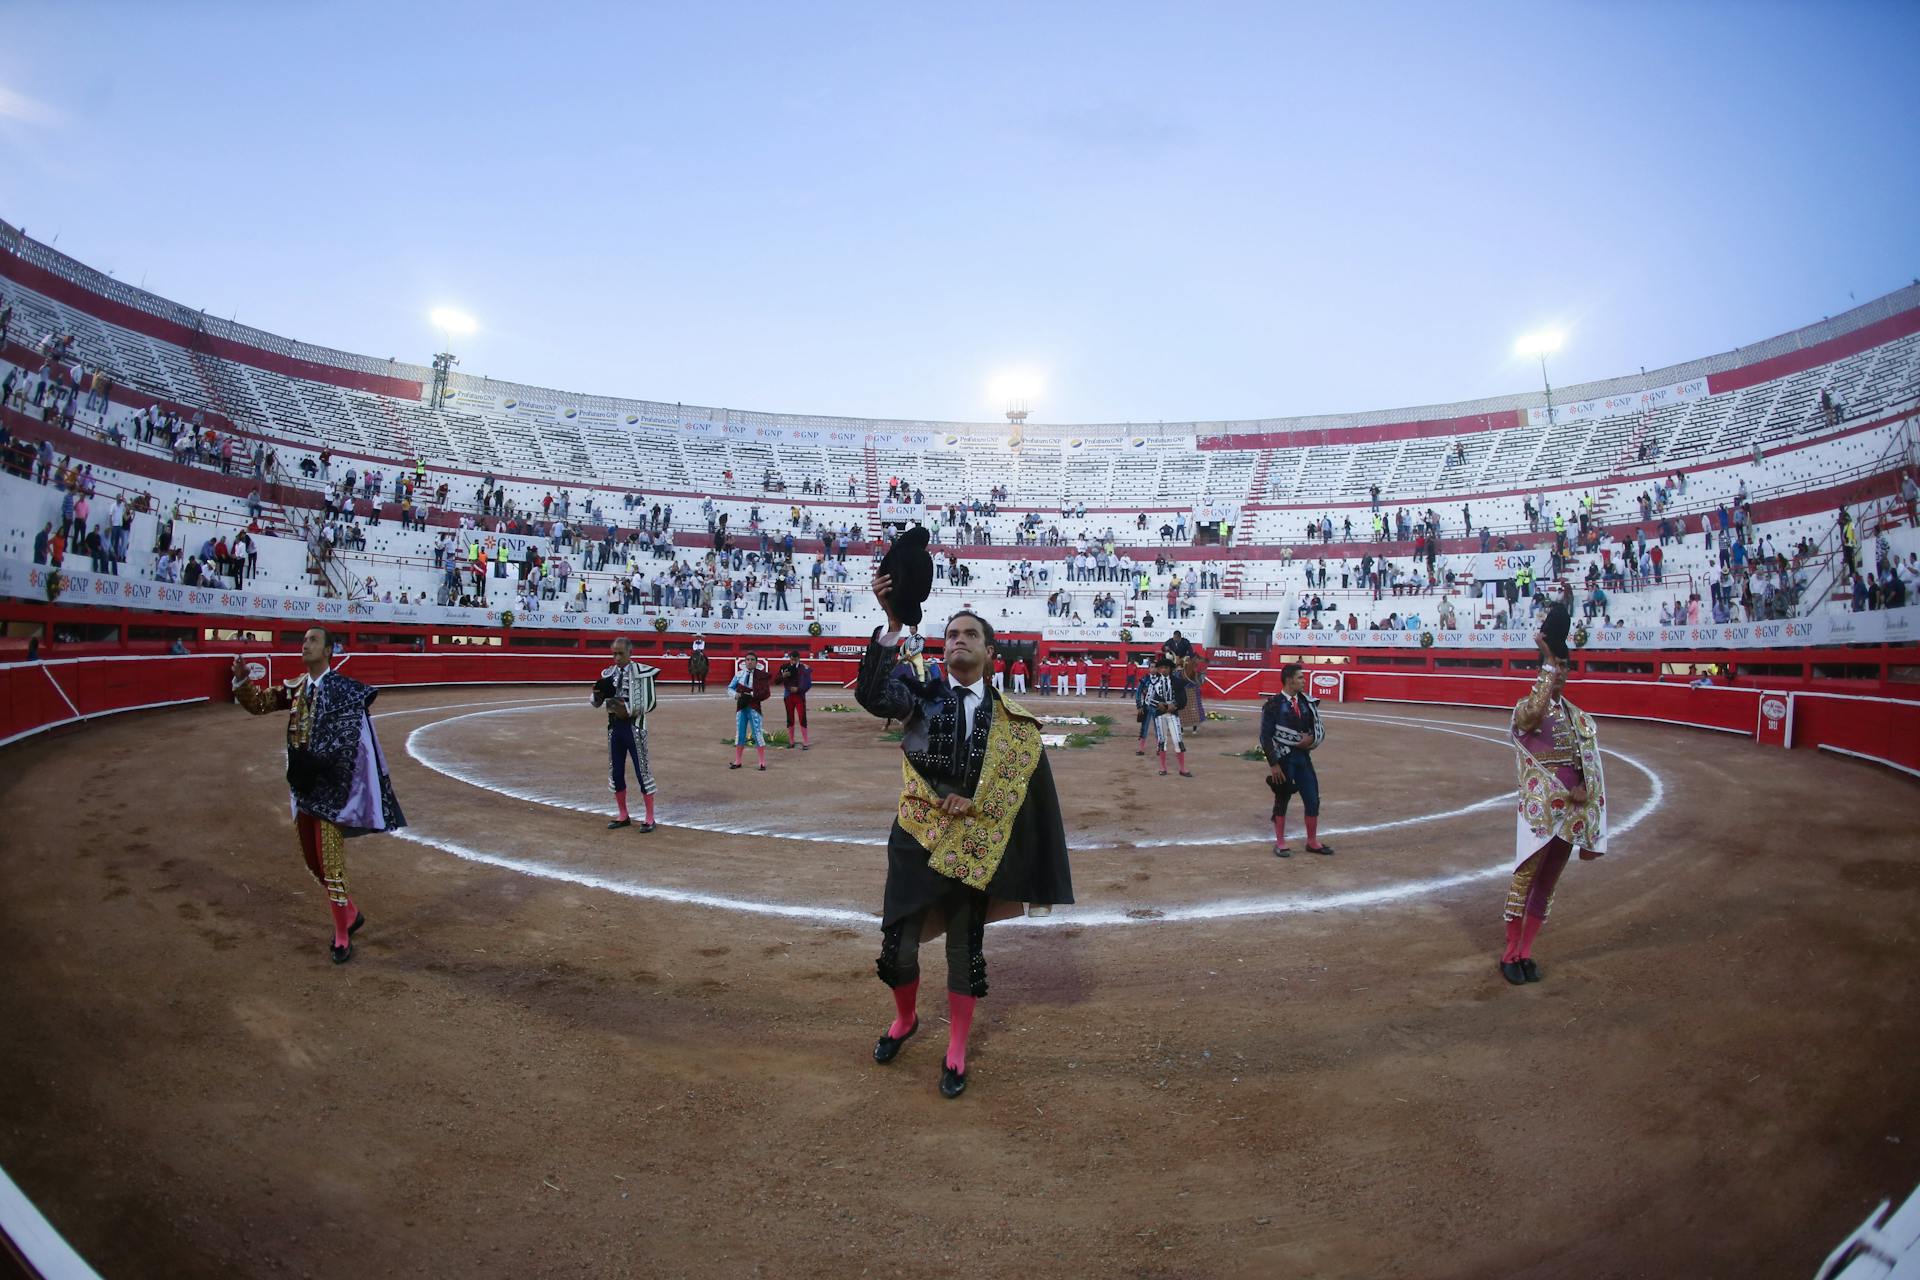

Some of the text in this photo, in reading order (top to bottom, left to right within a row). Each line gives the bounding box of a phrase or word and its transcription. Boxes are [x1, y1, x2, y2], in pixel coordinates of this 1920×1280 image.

[1685, 382, 1701, 394] GNP
[1650, 390, 1666, 400] GNP
[1577, 403, 1594, 413] GNP
[1613, 398, 1631, 407] GNP
[693, 423, 710, 431] GNP
[1211, 508, 1230, 516] GNP
[498, 538, 526, 551] GNP
[1507, 555, 1535, 568] GNP
[70, 576, 88, 592] GNP
[102, 580, 119, 593] GNP
[132, 582, 151, 596] GNP
[166, 587, 183, 599] GNP
[196, 592, 213, 604] GNP
[230, 595, 247, 606] GNP
[261, 598, 277, 609] GNP
[293, 600, 310, 611] GNP
[325, 603, 342, 613] GNP
[356, 604, 374, 614] GNP
[1636, 631, 1653, 640] GNP
[1668, 631, 1684, 640] GNP
[1700, 629, 1717, 640] GNP
[1732, 628, 1749, 639] GNP
[1762, 626, 1779, 638] GNP
[1794, 624, 1812, 636] GNP
[1445, 633, 1462, 641] GNP
[1477, 633, 1494, 641] GNP
[1510, 633, 1526, 641] GNP
[1604, 632, 1621, 640] GNP
